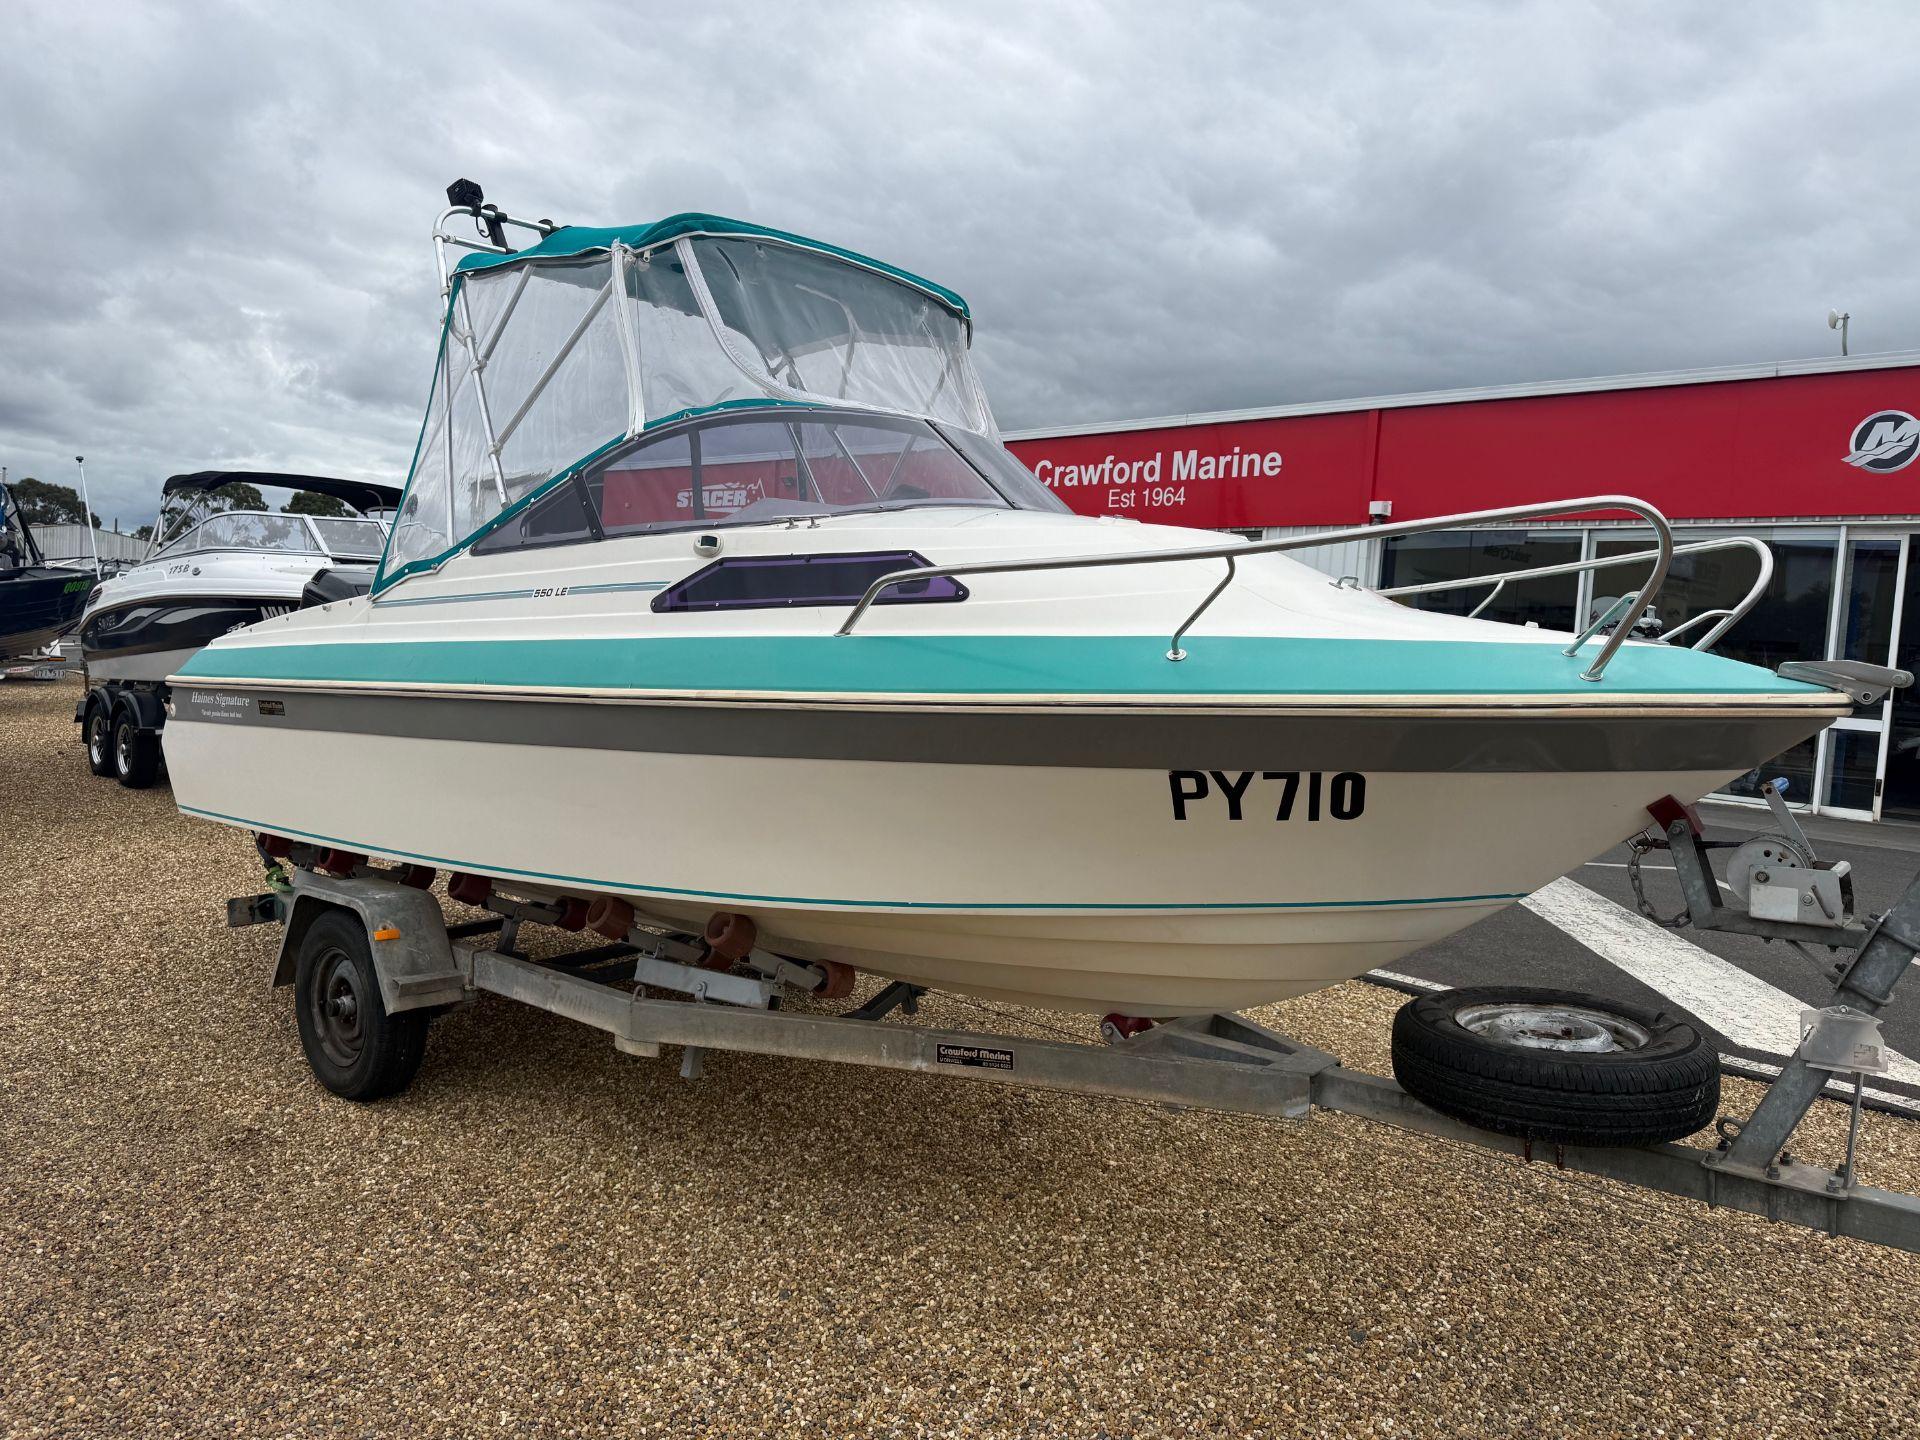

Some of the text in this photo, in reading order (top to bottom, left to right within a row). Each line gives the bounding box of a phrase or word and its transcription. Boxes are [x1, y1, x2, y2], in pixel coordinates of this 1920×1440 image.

[1035, 446, 1282, 487] Crawford Marine
[676, 488, 747, 508] SACER
[1108, 486, 1186, 508] Est 1964
[533, 587, 568, 598] 550 LE
[191, 691, 250, 707] Haines Signature
[1168, 769, 1367, 822] PY710
[940, 1046, 978, 1058] Crawford
[980, 1050, 1011, 1061] Marine
